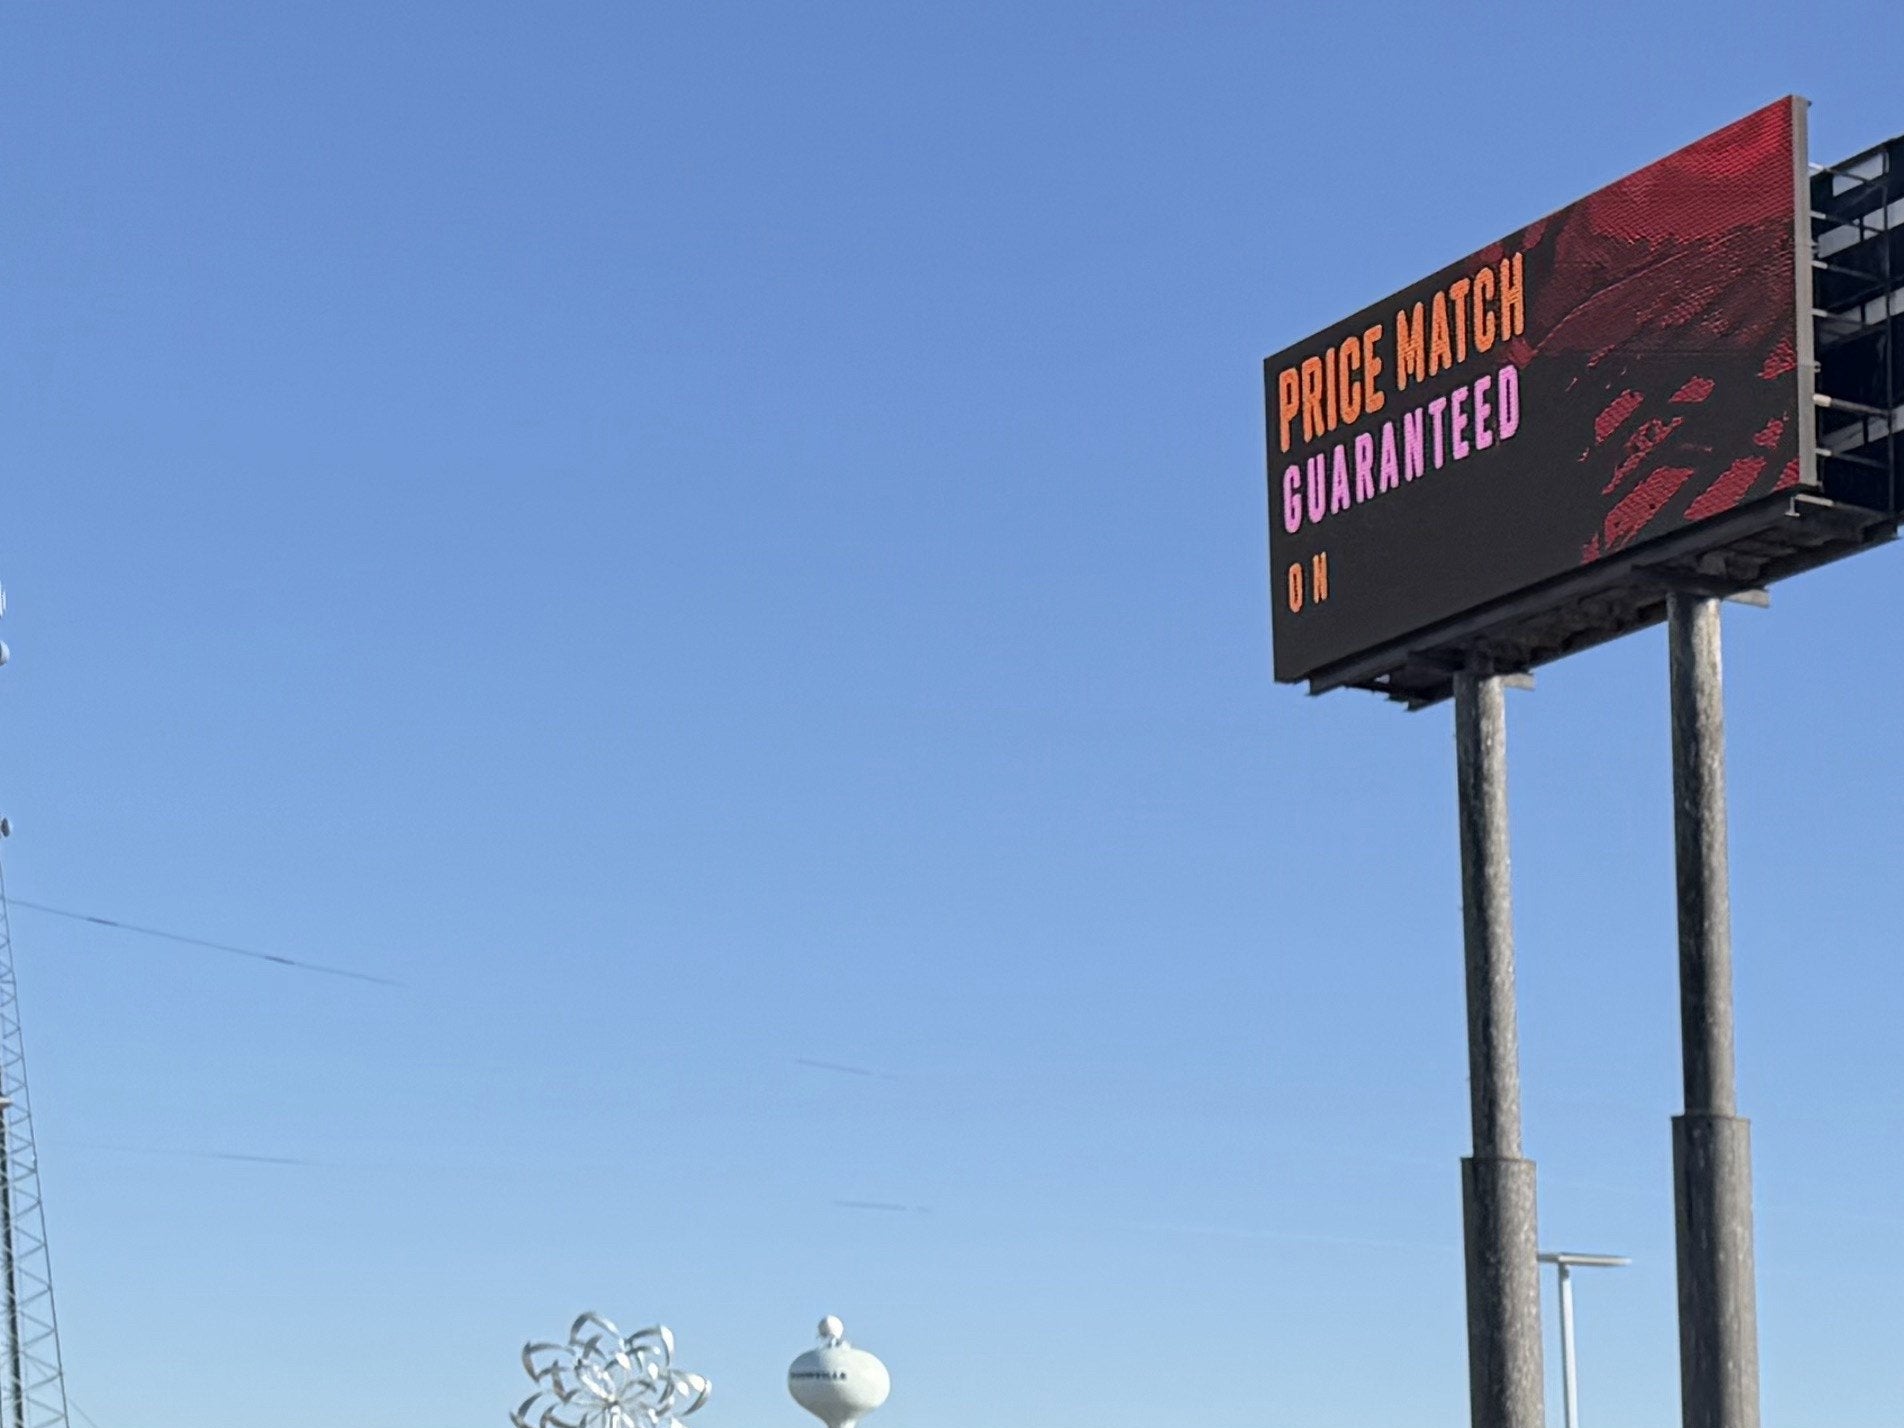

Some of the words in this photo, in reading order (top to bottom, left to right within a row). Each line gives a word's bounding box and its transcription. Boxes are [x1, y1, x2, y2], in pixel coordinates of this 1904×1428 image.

[1278, 324, 1386, 454] PRICE
[1396, 252, 1524, 392] MATCH
[1283, 364, 1520, 534] GUARANTEED
